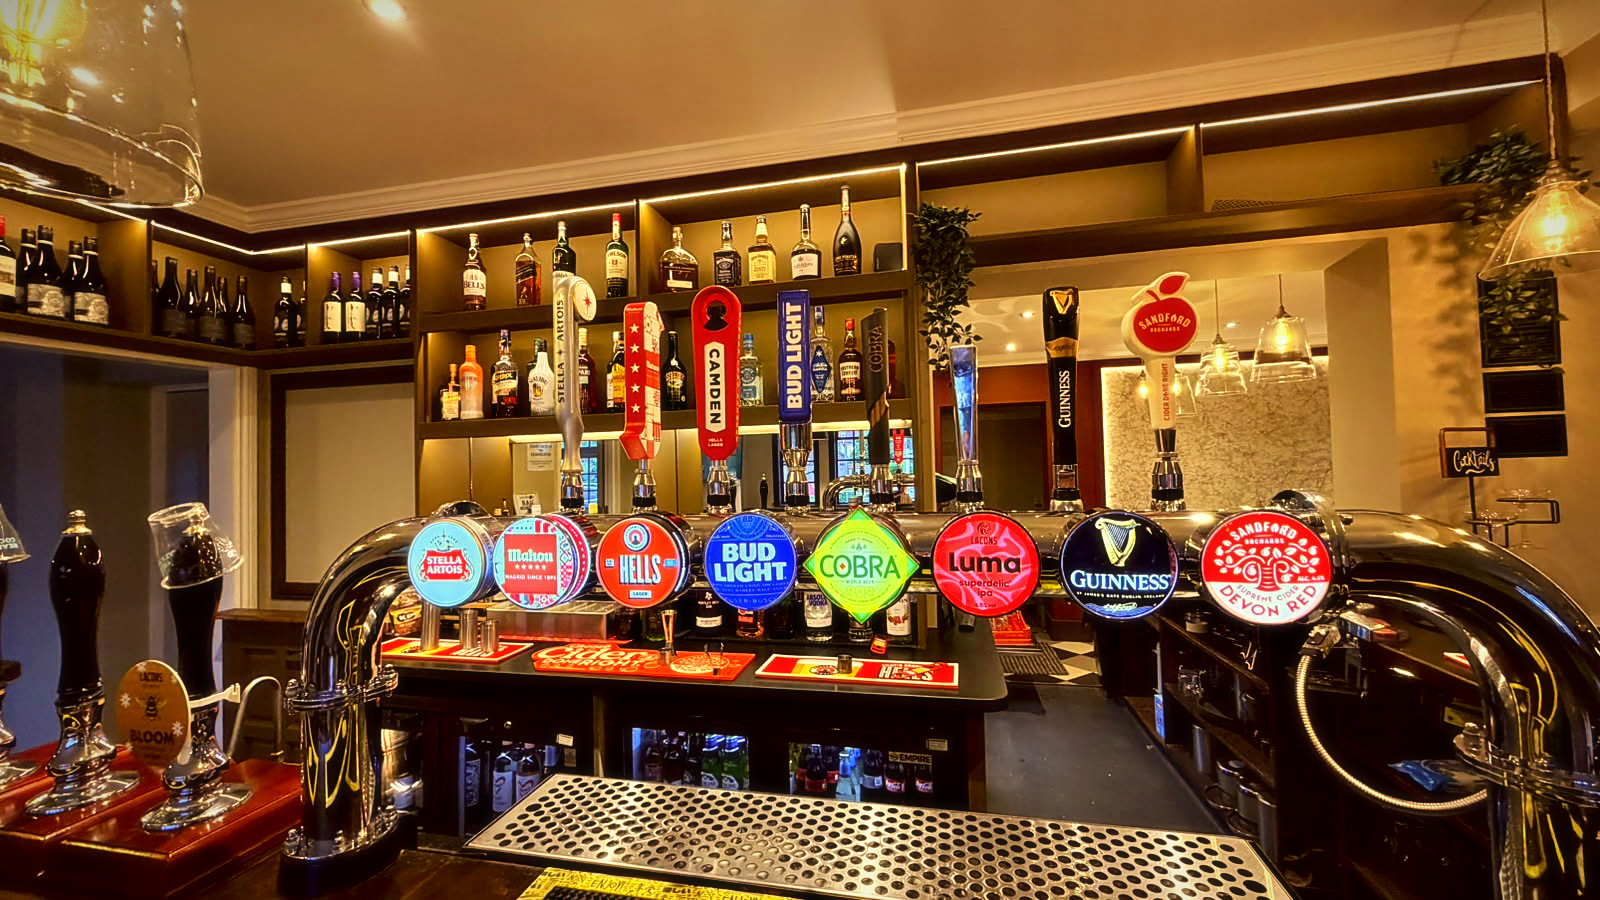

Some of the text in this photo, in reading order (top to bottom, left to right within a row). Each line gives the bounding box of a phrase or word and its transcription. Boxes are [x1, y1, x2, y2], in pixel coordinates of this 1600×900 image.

[1138, 312, 1191, 330] SANDFORD
[556, 299, 565, 403] STELLA ARTOIS
[786, 302, 803, 409] BUD LIGHT
[868, 326, 885, 373] COBRA
[1161, 363, 1169, 382] RIGHT
[708, 348, 722, 424] CAMDEN
[1058, 370, 1072, 428] GUINNESS
[1453, 450, 1496, 472] Cocktails
[971, 537, 998, 545] LACONS
[1230, 521, 1297, 541] SANDFORD
[426, 556, 463, 564] STELLA
[507, 549, 553, 562] Mahou
[722, 543, 776, 562] BUD
[949, 552, 1021, 573] Luma
[426, 565, 463, 574] ARTOIS
[619, 554, 662, 585] HELLS
[714, 562, 787, 582] LIGHT
[820, 554, 901, 579] COBRA
[1070, 569, 1169, 590] GUINNESS
[977, 589, 993, 598] ipa
[1220, 584, 1317, 616] DEVON RED
[1236, 584, 1299, 603] SUPREME CIDER
[537, 646, 649, 660] Cider
[130, 729, 175, 744] BLOOM
[900, 753, 932, 763] EMPIRE
